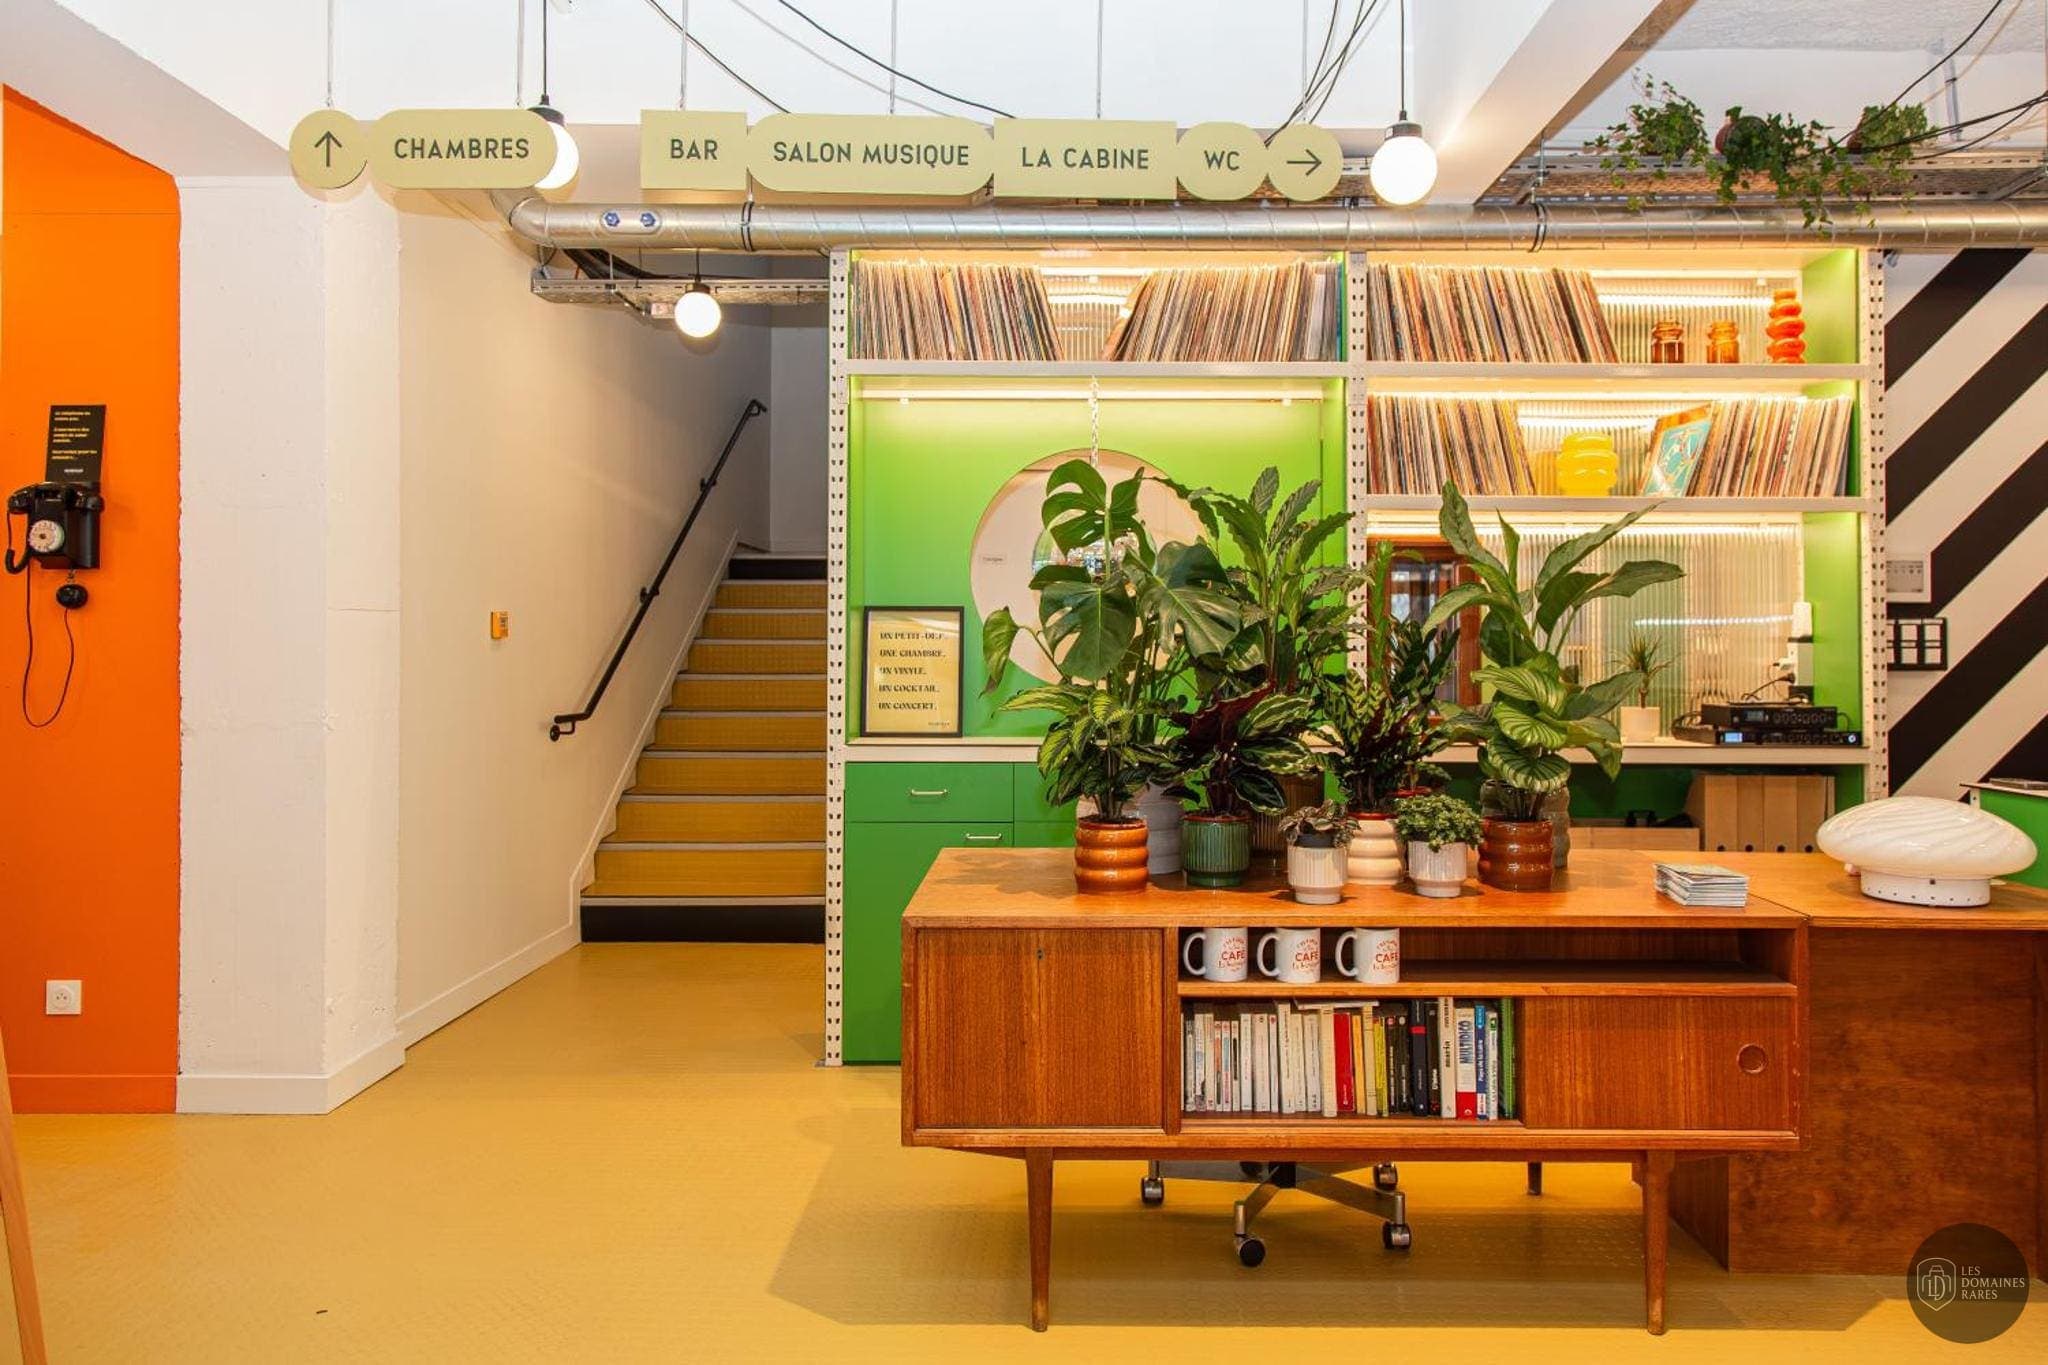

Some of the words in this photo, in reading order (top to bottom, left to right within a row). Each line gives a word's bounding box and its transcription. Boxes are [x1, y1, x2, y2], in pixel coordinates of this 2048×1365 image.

[394, 137, 529, 159] CHAMBRES
[670, 138, 718, 161] BAR
[773, 141, 851, 163] SALON
[862, 143, 969, 169] MUSIQUE
[1022, 146, 1052, 168] LA
[1063, 148, 1149, 170] CABINE
[1203, 150, 1240, 171] WC
[880, 649, 897, 657] UNE
